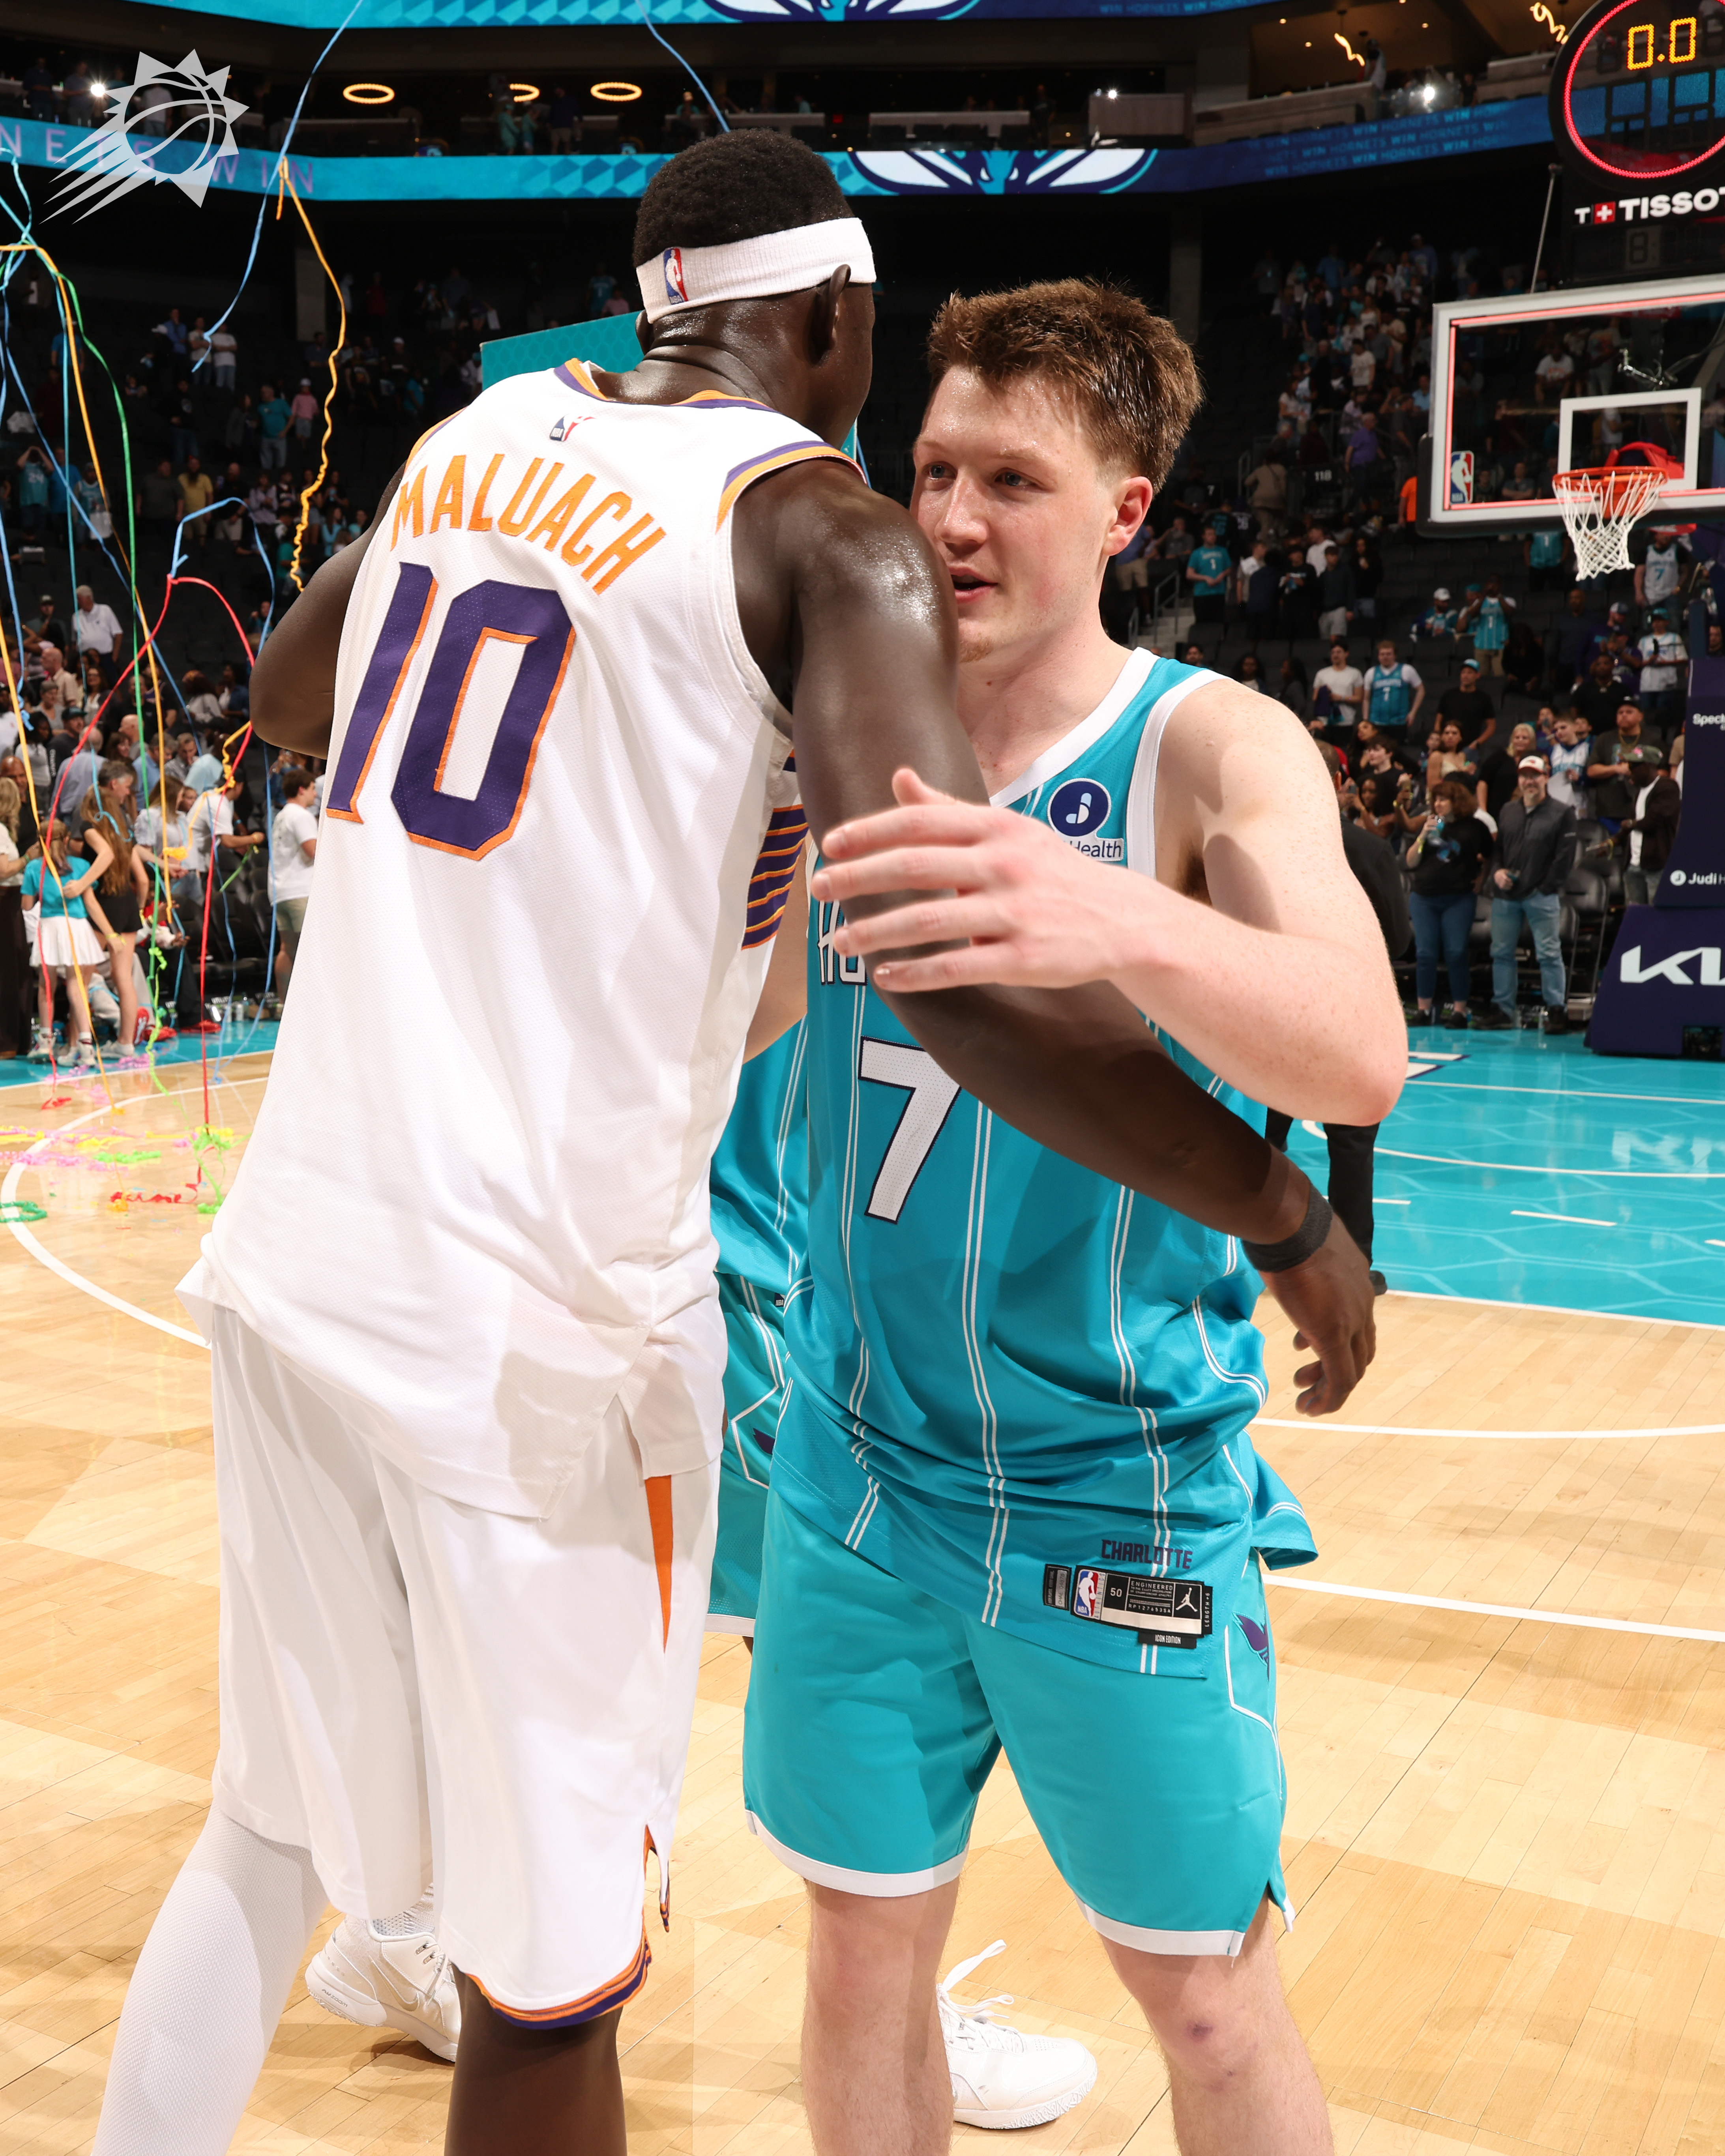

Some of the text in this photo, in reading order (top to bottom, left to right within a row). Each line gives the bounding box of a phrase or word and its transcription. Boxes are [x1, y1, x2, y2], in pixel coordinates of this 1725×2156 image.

[1627, 17, 1697, 70] 0.0
[669, 295, 682, 304] NBA
[551, 427, 564, 438] NBA
[390, 454, 666, 595] MALUACH
[1655, 569, 1664, 580] 7
[326, 561, 576, 862] 10
[1688, 871, 1718, 885] Judi
[858, 1035, 962, 1224] 7
[1101, 1539, 1193, 1570] CHARLOTTE
[1131, 1580, 1173, 1591] ENGINEERED
[1110, 1587, 1122, 1598] 50
[1078, 1605, 1088, 1615] NBA
[1155, 1634, 1181, 1645] ICON EDITION
